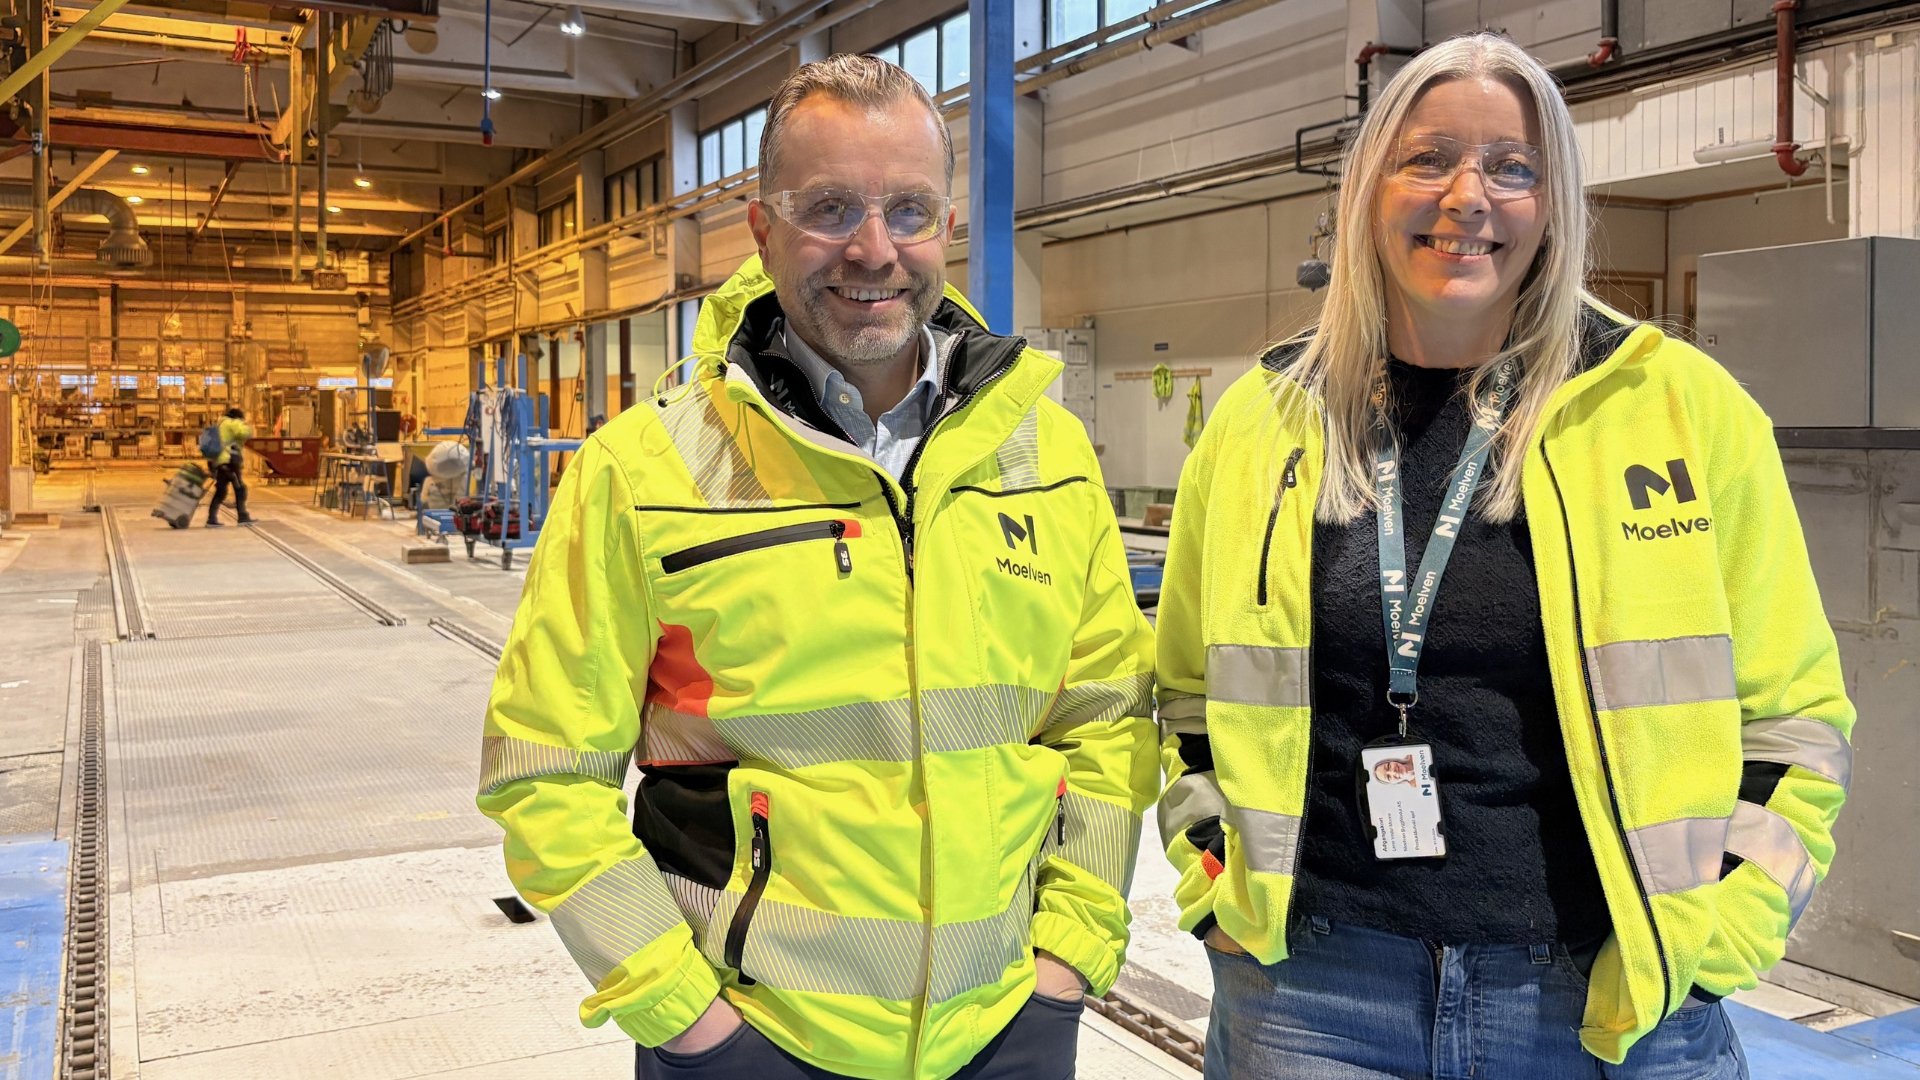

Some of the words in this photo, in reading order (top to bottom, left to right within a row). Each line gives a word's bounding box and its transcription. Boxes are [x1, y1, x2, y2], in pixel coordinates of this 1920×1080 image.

[1448, 461, 1478, 510] Moelven
[1382, 487, 1396, 536] Moelven
[995, 556, 1052, 587] Moelven
[1408, 571, 1437, 626] Moelven
[1389, 600, 1402, 647] Moelv
[1419, 749, 1429, 780] Moelven
